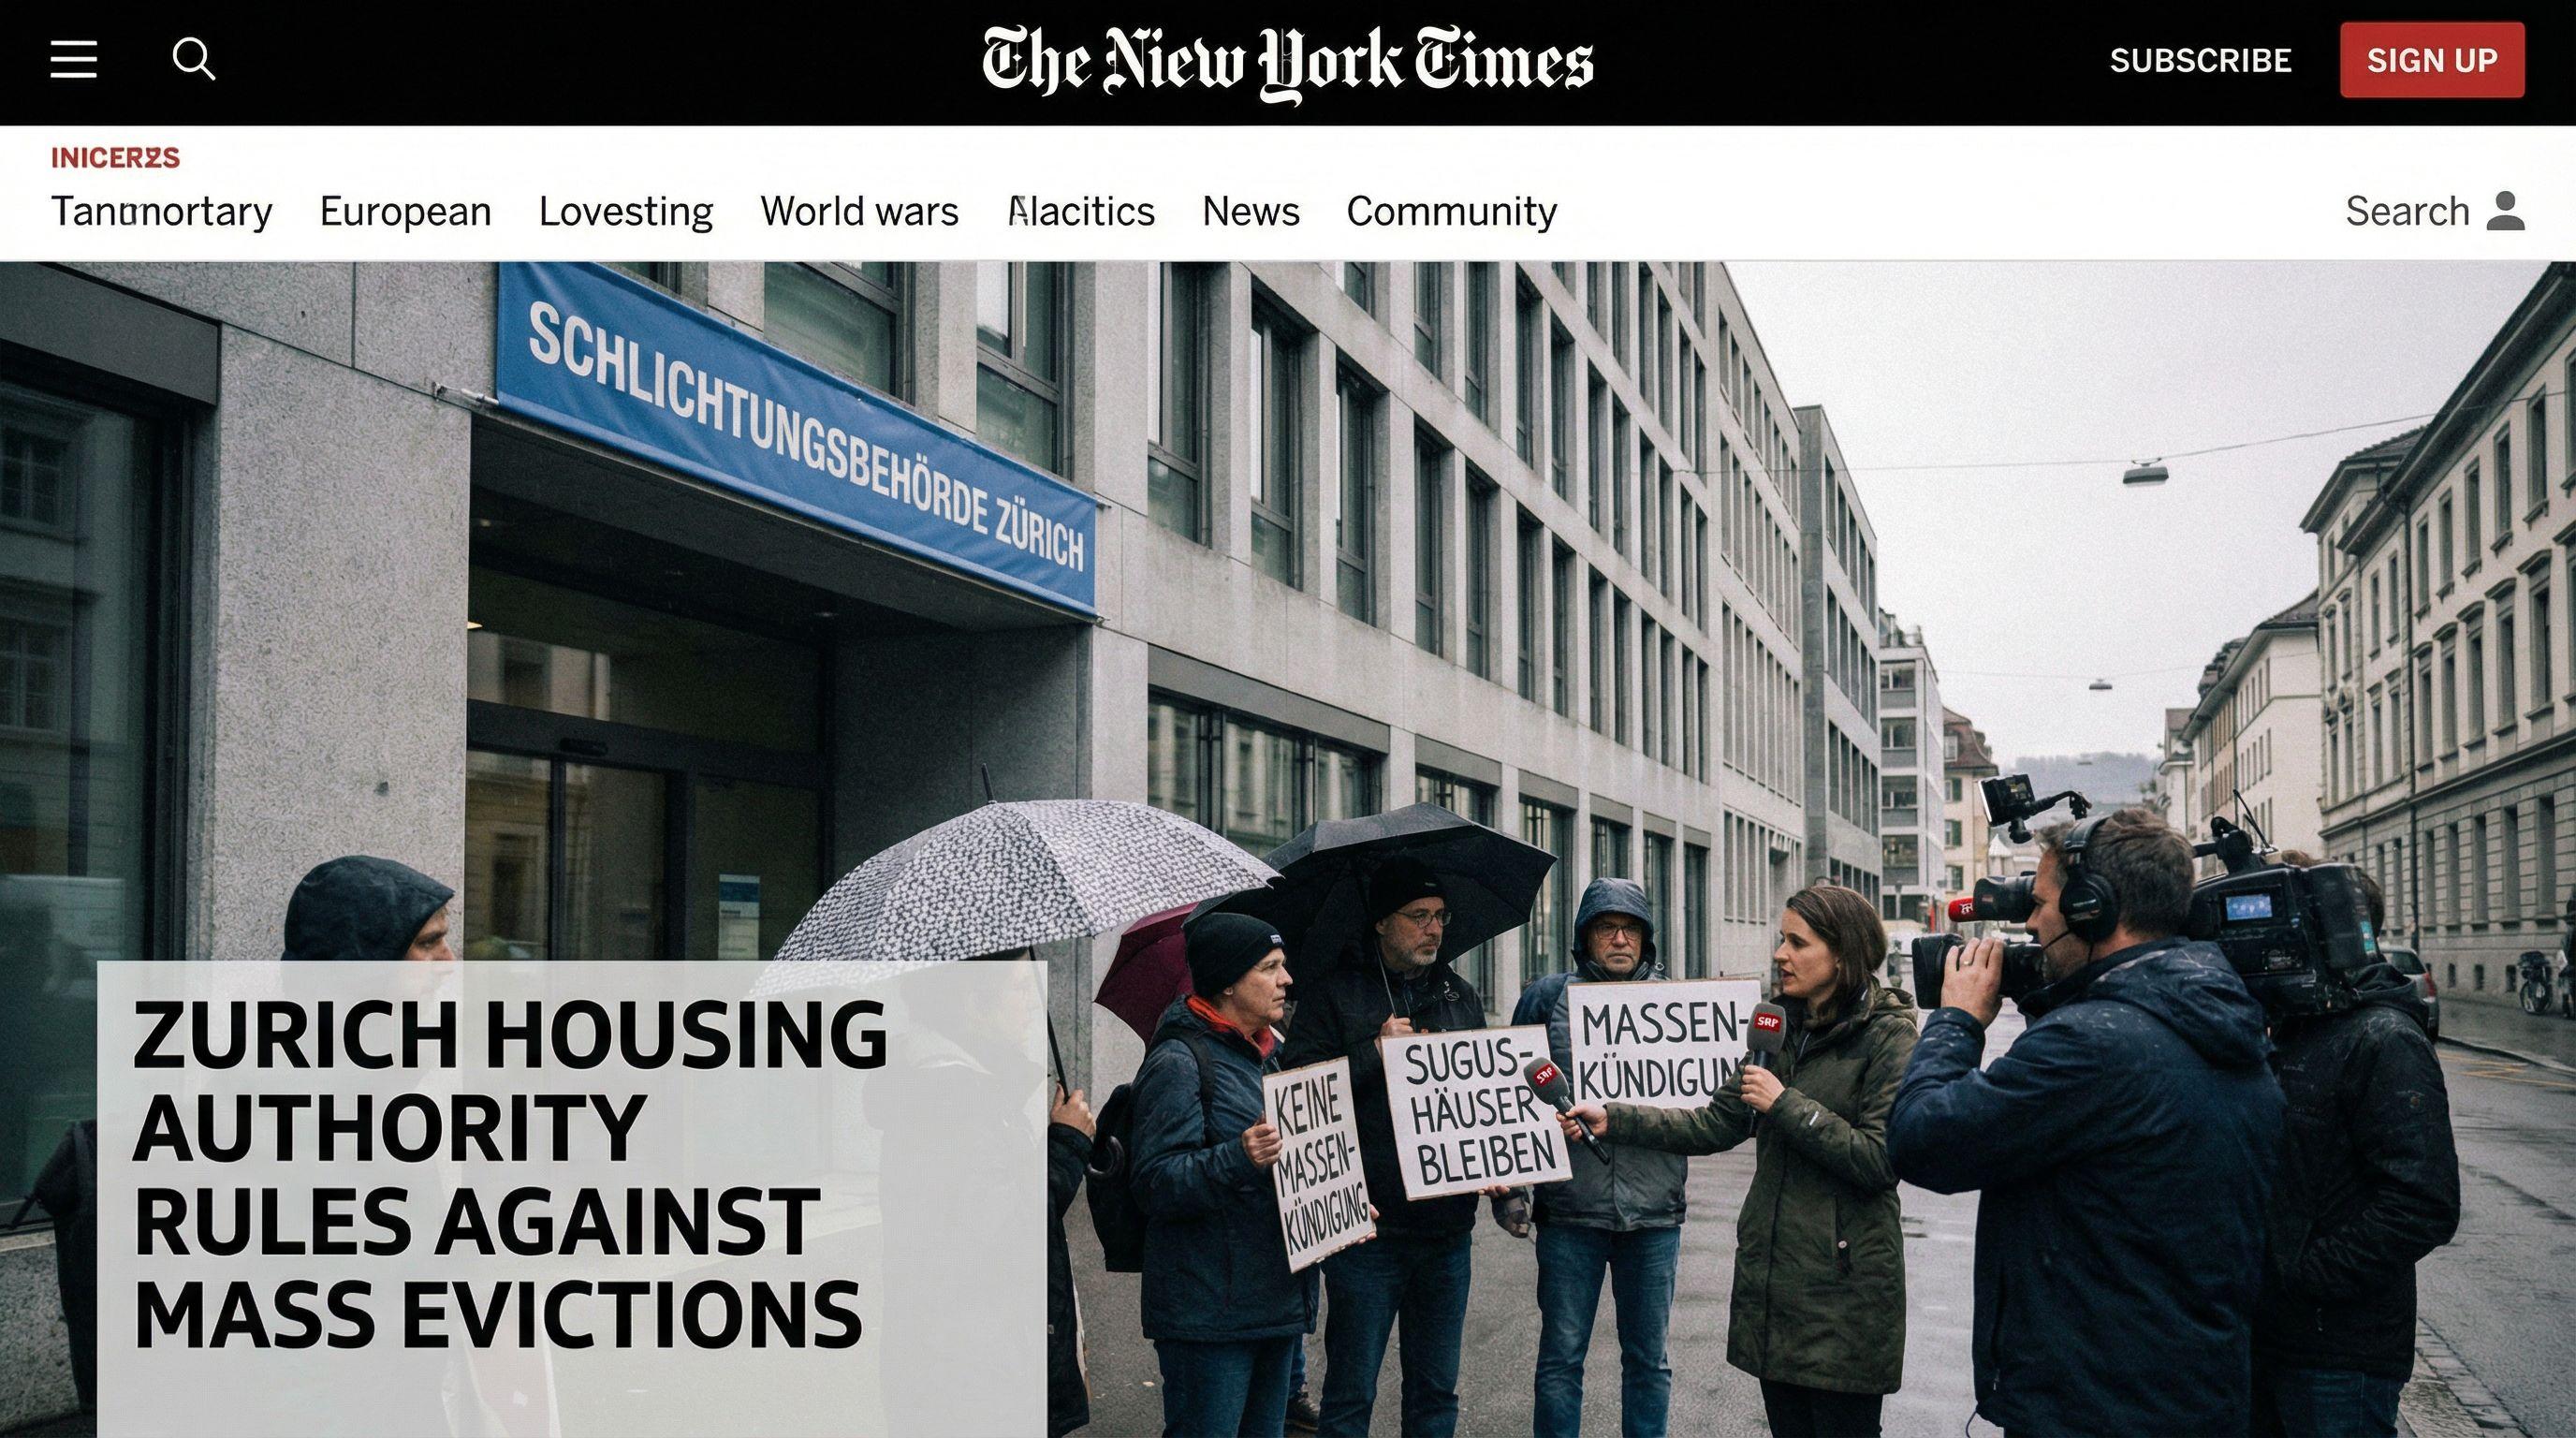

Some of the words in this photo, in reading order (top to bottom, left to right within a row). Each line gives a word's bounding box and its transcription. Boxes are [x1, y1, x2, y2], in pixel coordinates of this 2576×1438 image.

[528, 301, 988, 536] SCHLICHTUNGSBEHÖRDE
[995, 495, 1084, 572] ZÜRICH
[1582, 1001, 1749, 1046] MASSEN-
[1406, 1037, 1533, 1085] SUGUS-
[1580, 1052, 1739, 1100] KÜNDIGUN
[1275, 1073, 1342, 1139] KEINE
[1411, 1085, 1540, 1135] HÄUSER
[1278, 1131, 1355, 1197] MASSEN-
[1417, 1130, 1557, 1185] BLEIBEN
[1284, 1181, 1368, 1255] KÜNDIGUNG
